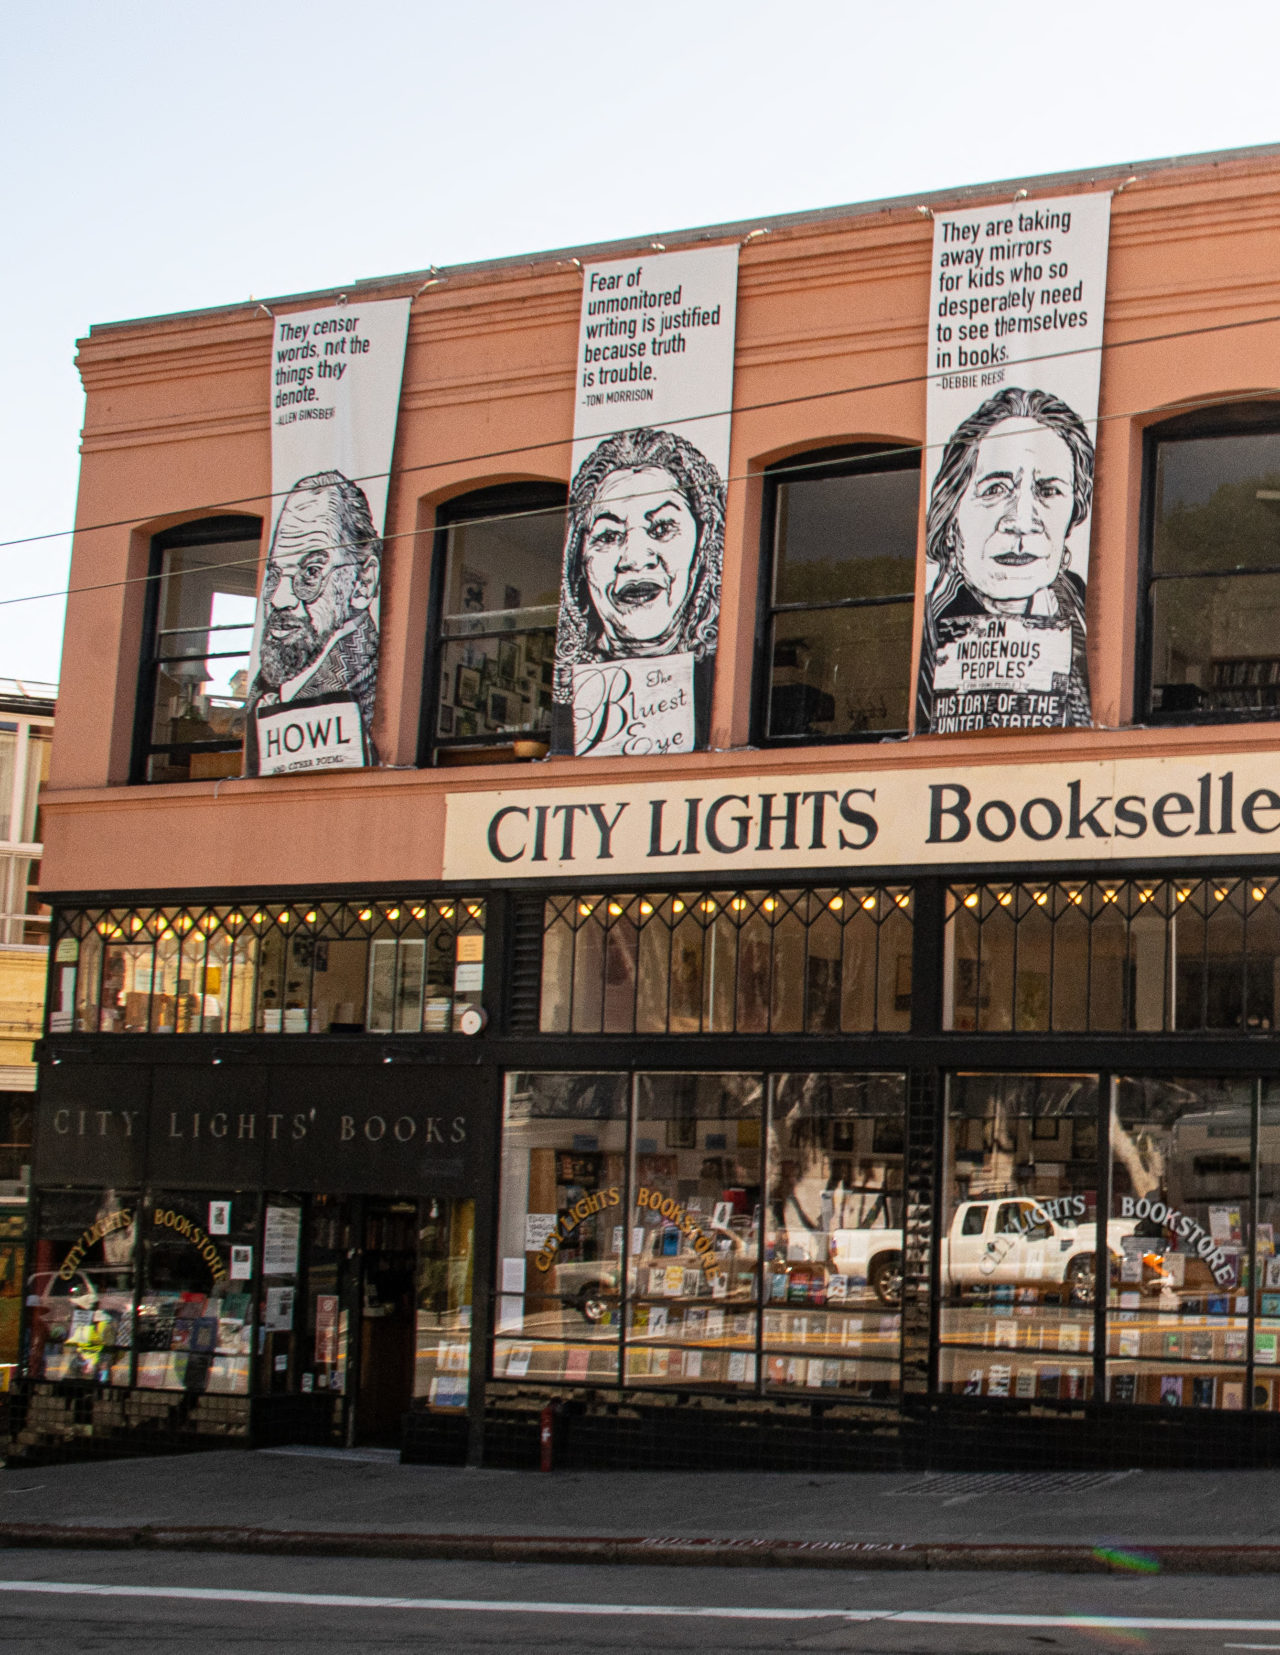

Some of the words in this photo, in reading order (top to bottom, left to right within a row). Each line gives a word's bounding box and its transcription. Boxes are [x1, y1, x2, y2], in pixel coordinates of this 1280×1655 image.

[942, 222, 981, 245] They
[986, 218, 1013, 237] are
[1018, 209, 1071, 234] taking
[940, 247, 984, 268] away
[989, 238, 1052, 262] mirrors
[590, 272, 623, 293] Fear
[626, 266, 643, 288] of
[939, 272, 963, 292] for
[968, 265, 1005, 289] kids
[1010, 261, 1043, 283] who
[1049, 261, 1068, 279] so
[587, 284, 682, 316] unmonitored
[938, 286, 1035, 320] desperately
[1040, 280, 1083, 305] need
[279, 323, 310, 342] They
[313, 317, 360, 337] censor
[585, 316, 637, 340] writing
[642, 313, 655, 333] is
[659, 304, 721, 337] justified
[936, 323, 952, 343] to
[958, 323, 989, 341] see
[995, 308, 1088, 337] themselves
[276, 341, 320, 364] words,
[324, 337, 347, 356] not
[350, 336, 370, 354] the
[584, 341, 647, 364] because
[651, 333, 687, 356] truth
[936, 347, 951, 369] in
[958, 342, 1009, 368] books.
[275, 366, 314, 386] things
[317, 359, 347, 381] they
[583, 367, 594, 388] is
[598, 361, 657, 385] trouble.
[981, 368, 1006, 387] REESE
[275, 386, 320, 409] denote.
[606, 388, 654, 405] MORRISON
[987, 621, 1007, 638] AN
[956, 640, 1041, 660] INDIGENOUS
[646, 669, 672, 688] The
[960, 661, 1034, 680] PEOPLES'
[572, 663, 687, 757] Bluest
[936, 693, 989, 718] HISTORY
[997, 693, 1018, 713] OF
[1028, 694, 1060, 715] THE
[266, 716, 351, 758] HOWL
[621, 721, 684, 756] Eye
[937, 715, 984, 735] UNITED
[991, 713, 1053, 729] STATES
[315, 755, 345, 766] POEMS
[486, 801, 630, 863] CITY
[648, 787, 879, 859] LIGHTS
[53, 1109, 139, 1136] CITY
[340, 1115, 467, 1144] BOOKS
[535, 1226, 564, 1272] CITY
[560, 1187, 621, 1232] LIGHTS
[1010, 1195, 1086, 1239] LIGHTS
[1121, 1196, 1235, 1286] BOOKSTORE
[59, 1238, 87, 1281] CITY
[83, 1208, 132, 1247] LIGHTS
